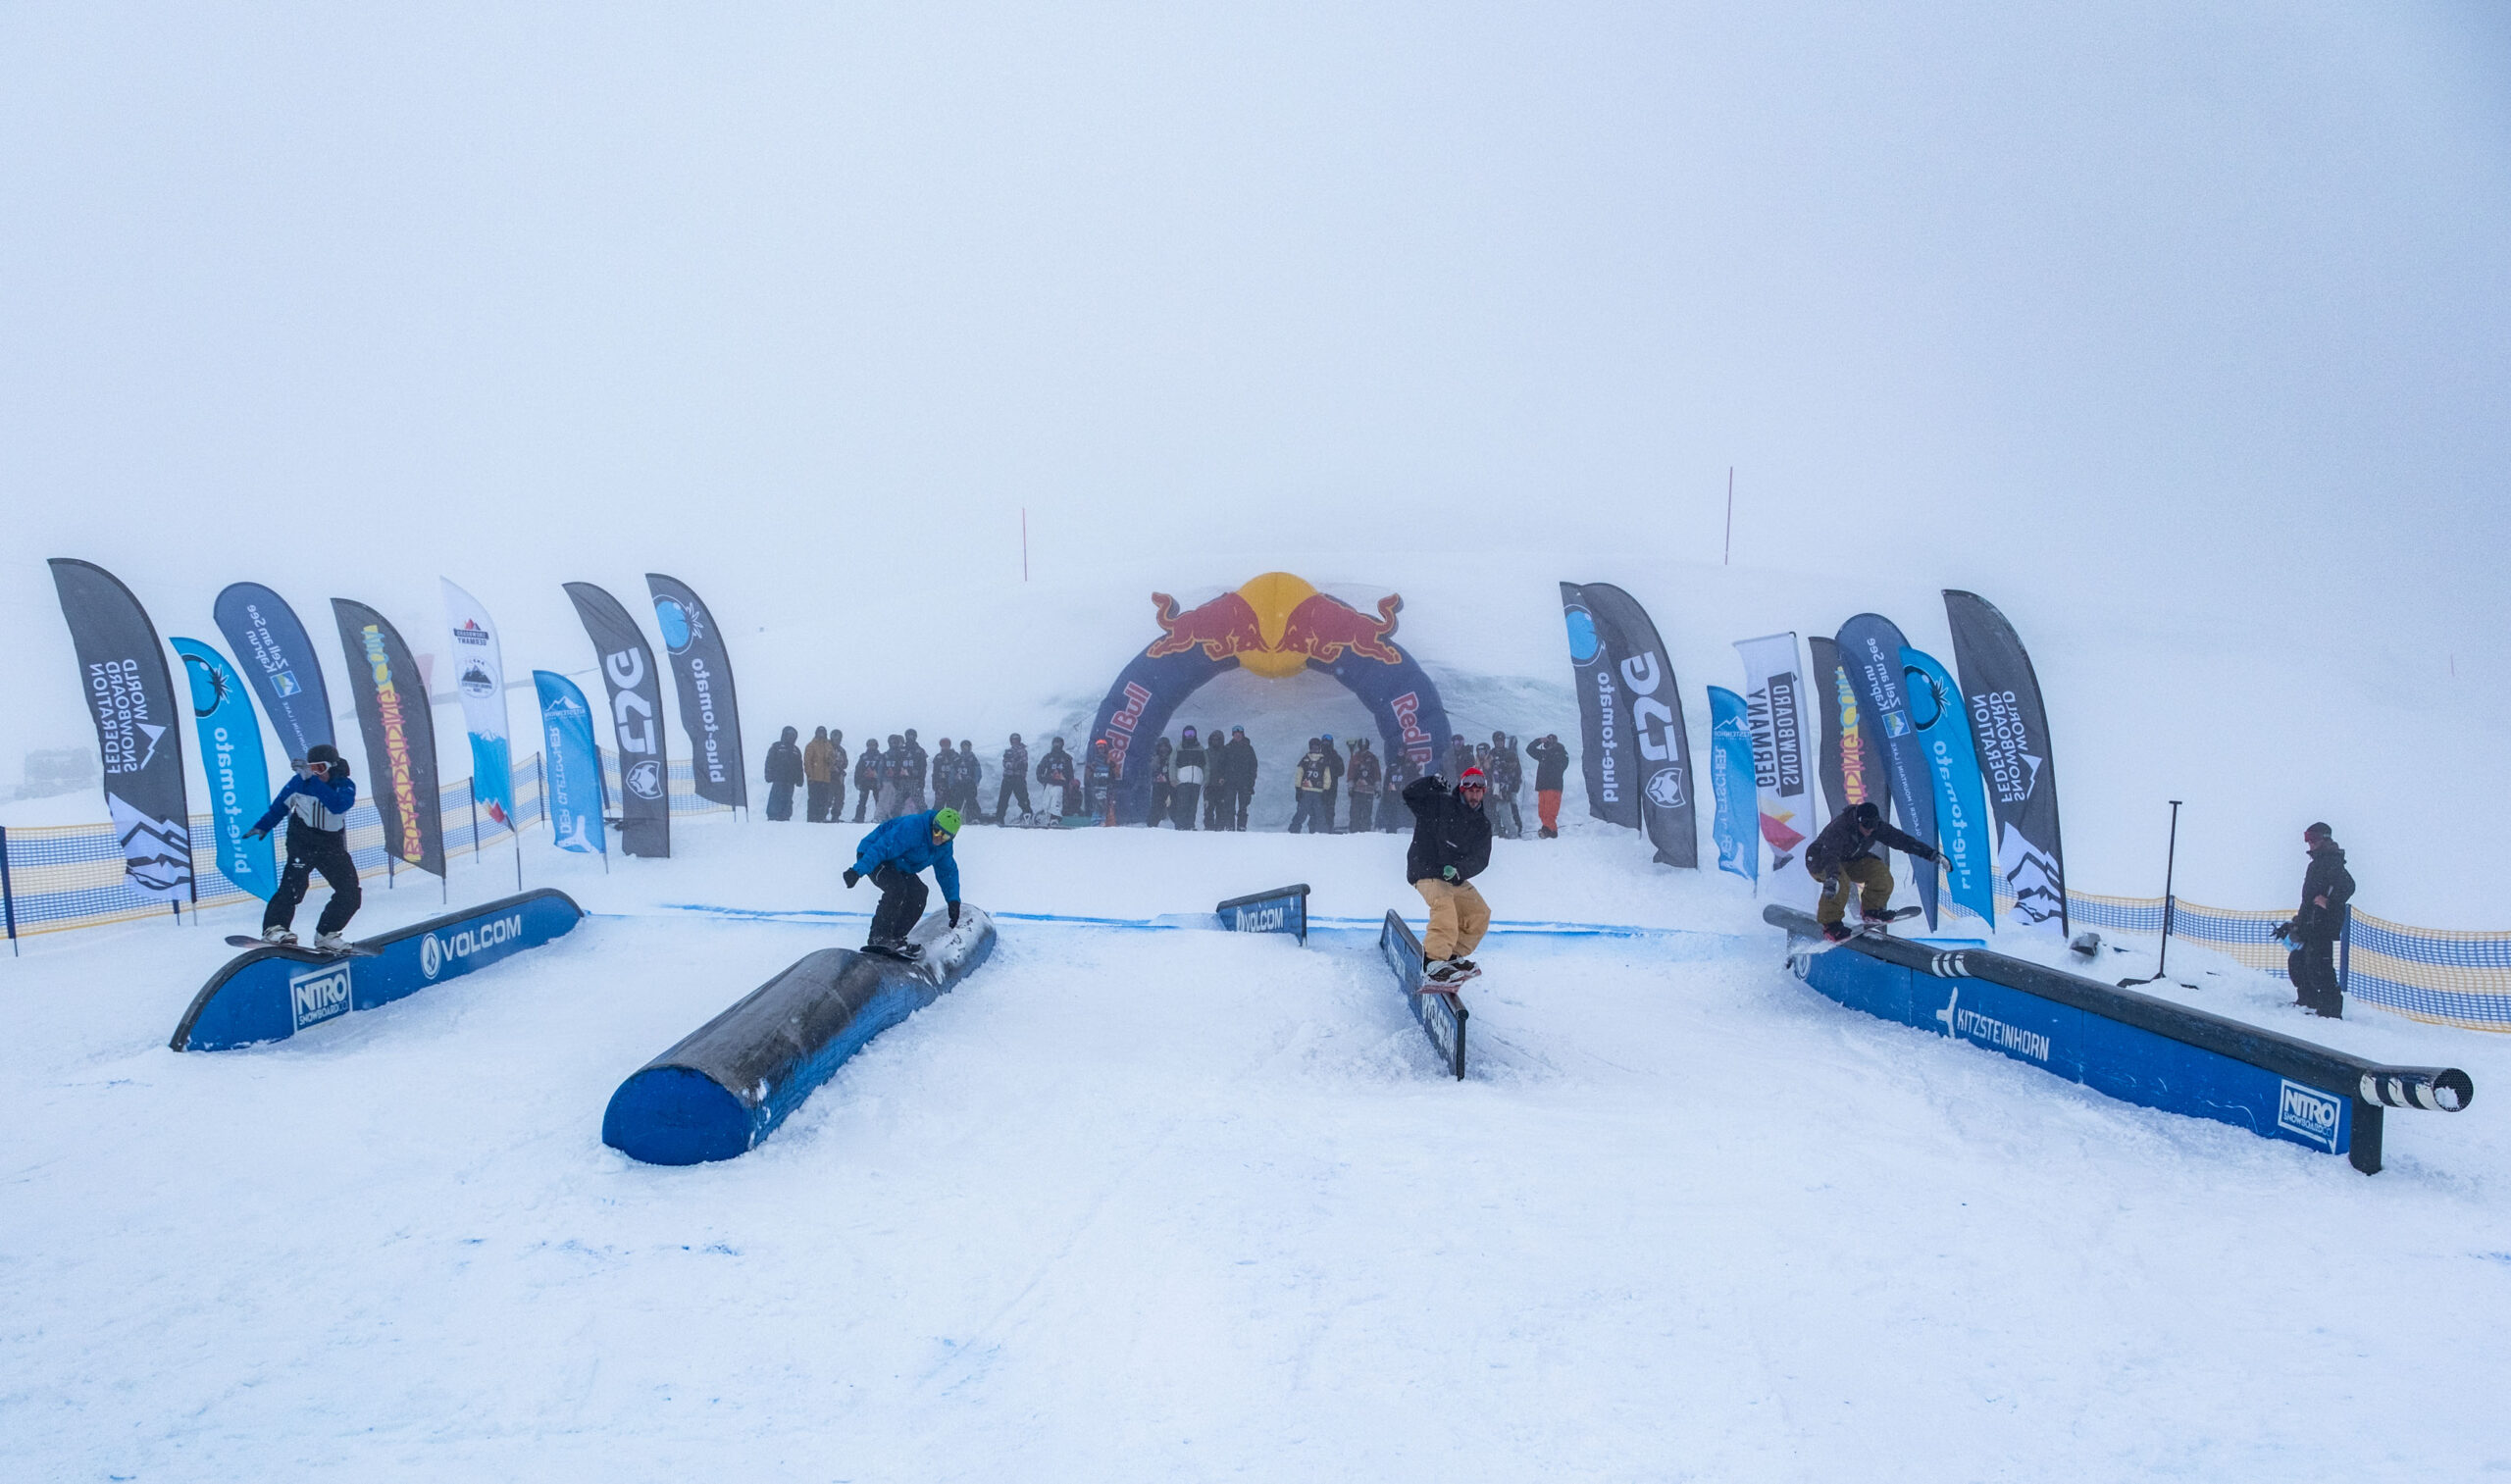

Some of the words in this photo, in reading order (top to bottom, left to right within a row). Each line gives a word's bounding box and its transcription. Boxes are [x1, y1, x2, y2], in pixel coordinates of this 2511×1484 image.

[1110, 681, 1153, 732] Bull
[1391, 691, 1431, 745] Red
[440, 914, 521, 962] VOLCOM
[1244, 907, 1284, 933] VOLCOM
[296, 973, 347, 1014] NITRO
[1957, 1008, 2050, 1062] KITZSTEINHORN
[2284, 1089, 2334, 1128] NITRO
